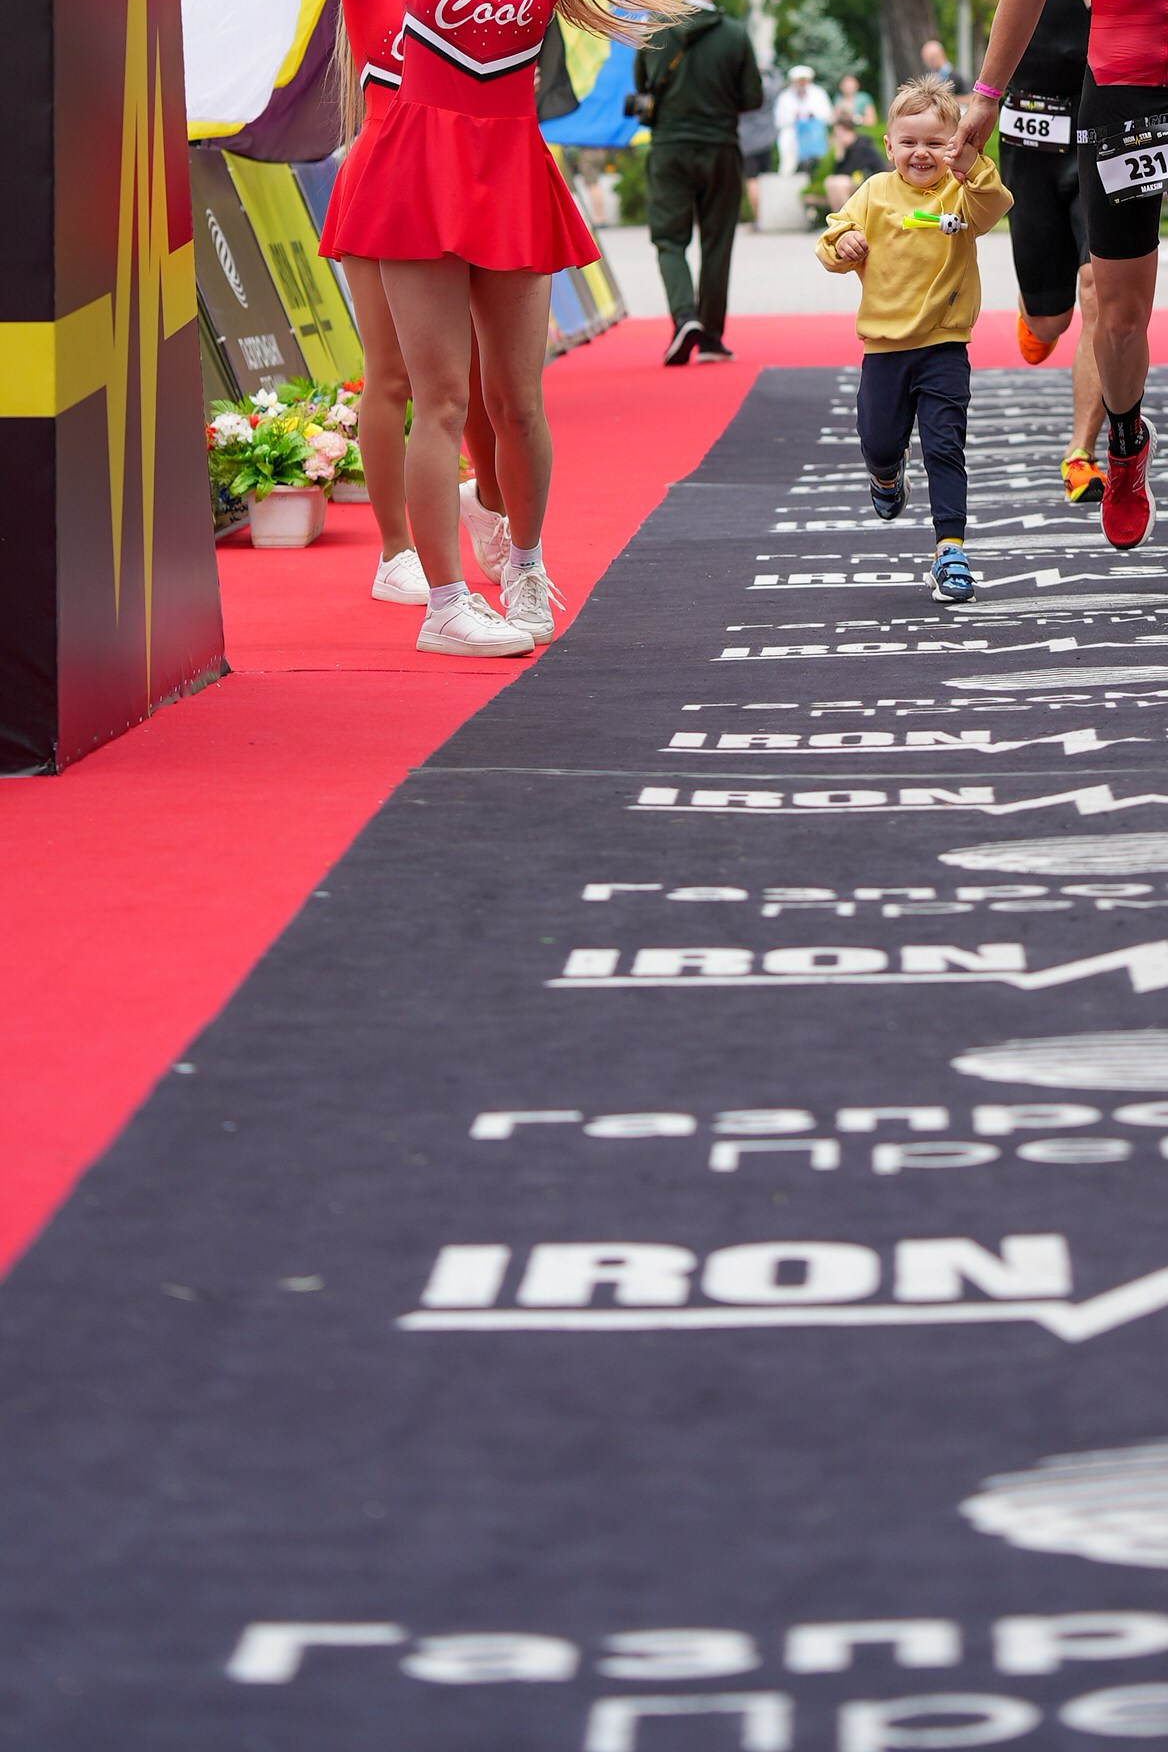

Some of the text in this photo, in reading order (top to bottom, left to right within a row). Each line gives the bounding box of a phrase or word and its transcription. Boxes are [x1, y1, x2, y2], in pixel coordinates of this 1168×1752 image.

[1013, 116, 1051, 138] 468
[1124, 151, 1168, 181] 231
[720, 639, 989, 658] IRON
[668, 730, 992, 748] IRON
[637, 785, 996, 808] IRON
[562, 943, 1027, 977] IRON
[421, 1233, 1073, 1309] IRON
